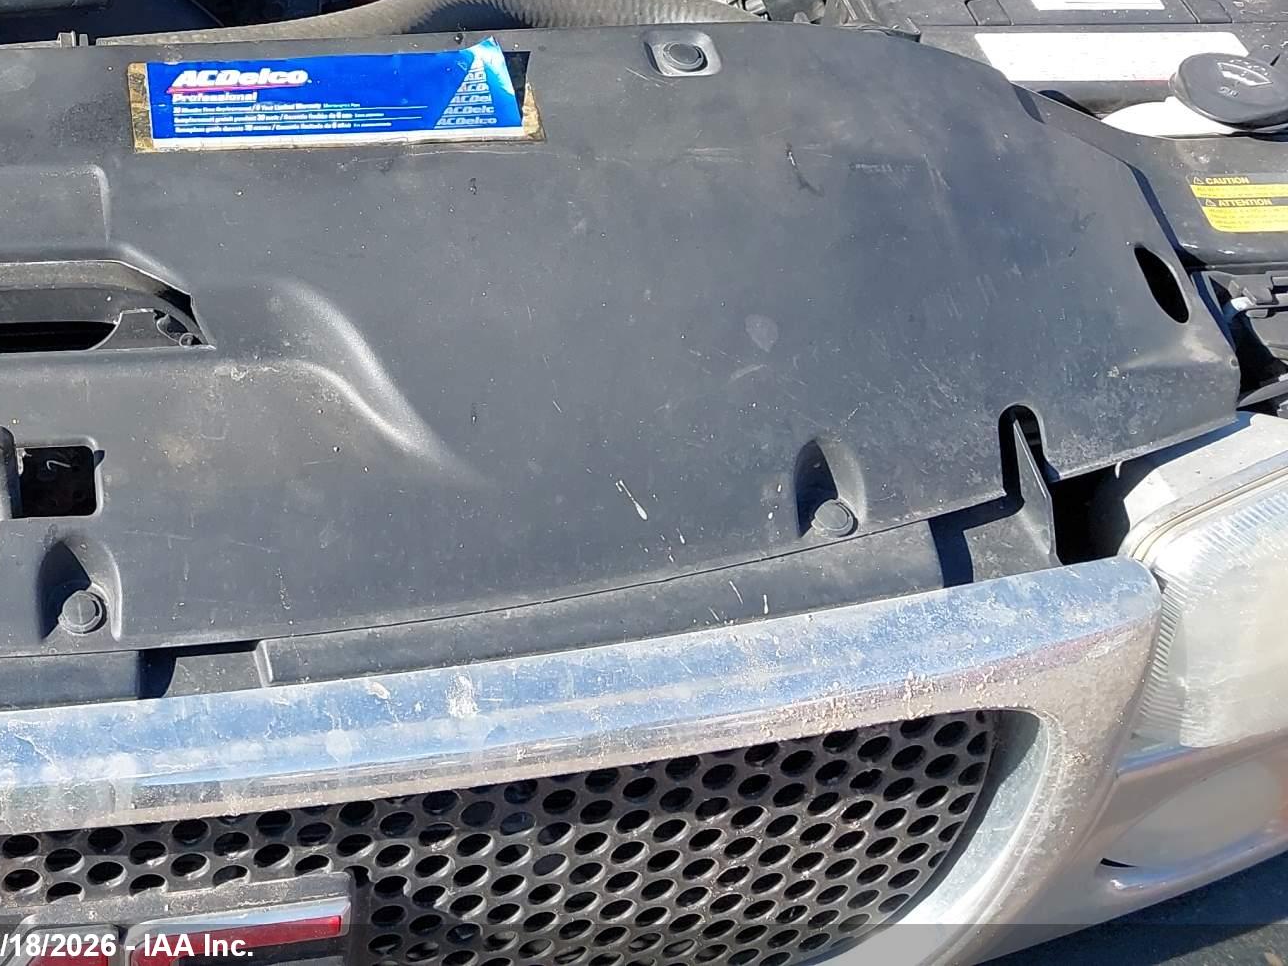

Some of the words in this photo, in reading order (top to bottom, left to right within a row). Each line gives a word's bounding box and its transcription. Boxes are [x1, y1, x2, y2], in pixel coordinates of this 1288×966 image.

[170, 68, 309, 88] ACDelco
[172, 91, 257, 102] Professional
[435, 116, 497, 126] ACDelco
[1205, 176, 1250, 185] CAUTION
[1218, 198, 1273, 206] ATTENTION
